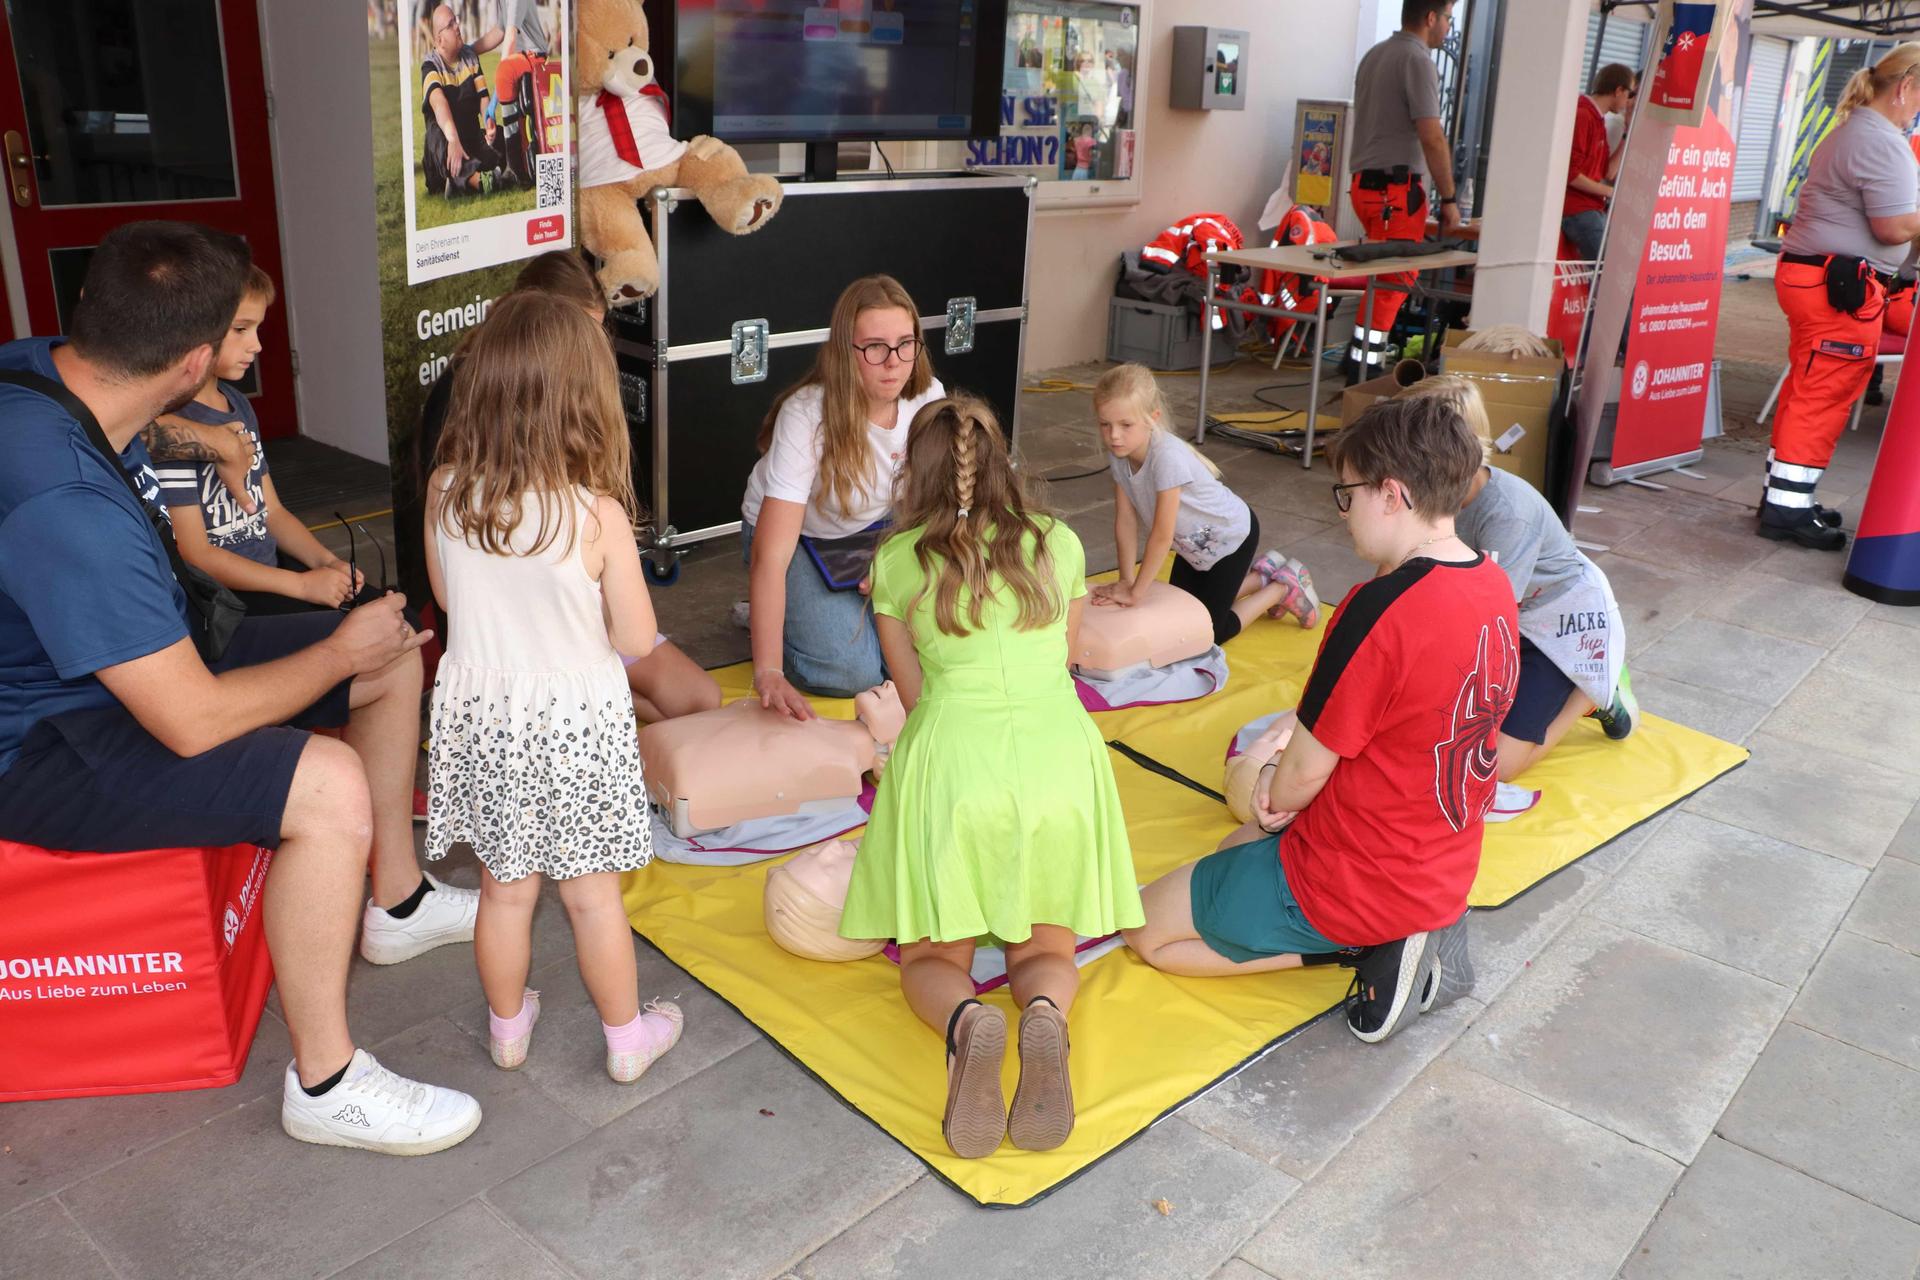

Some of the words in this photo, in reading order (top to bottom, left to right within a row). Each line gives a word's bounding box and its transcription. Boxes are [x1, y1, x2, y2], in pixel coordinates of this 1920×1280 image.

[1000, 95, 1016, 126] N
[966, 135, 1059, 165] SCHON?
[1668, 143, 1681, 165] ür
[1682, 144, 1700, 166] ein
[1702, 147, 1731, 172] gutes
[1658, 175, 1697, 197] Gefühl.
[1700, 177, 1726, 198] Auch
[1653, 207, 1681, 229] nach
[1683, 207, 1707, 229] dem
[416, 242, 429, 253] Dein
[431, 235, 459, 250] Ehrenamt
[1649, 238, 1693, 261] Besuch.
[416, 250, 460, 268] Sanitätsdienst
[417, 294, 493, 341] Gemein
[1562, 298, 1581, 314] Aus
[1649, 320, 1666, 332] 0800
[1651, 363, 1704, 386] JOHANNITER
[1576, 633, 1605, 660] Sup
[0, 952, 184, 980] JOHANNITER
[0, 987, 32, 1000] Aus
[36, 984, 86, 999] Liebe
[90, 984, 128, 997] zum
[132, 981, 187, 995] Leben
